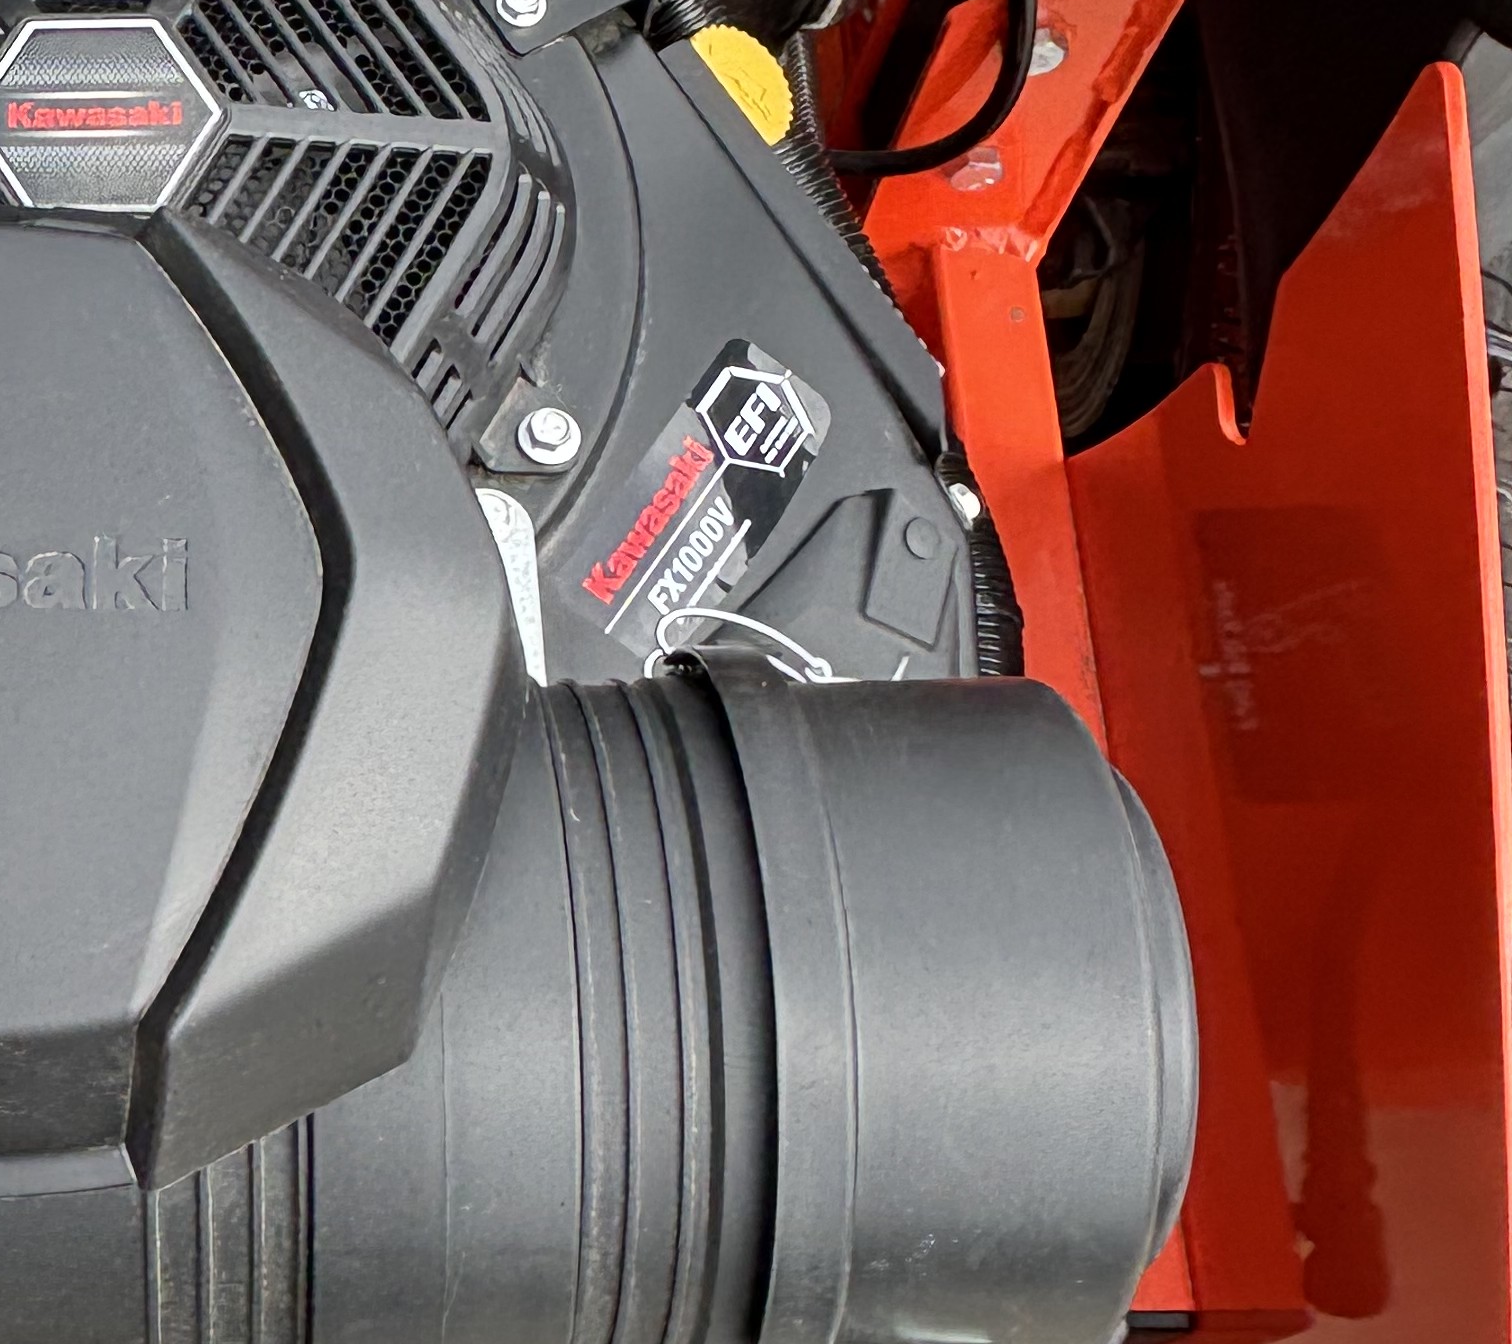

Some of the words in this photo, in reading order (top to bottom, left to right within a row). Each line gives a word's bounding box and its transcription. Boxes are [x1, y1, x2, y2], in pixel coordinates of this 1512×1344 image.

[6, 100, 183, 129] Kawasaki
[724, 382, 781, 456] EFI
[583, 436, 714, 604] Kawasaki
[647, 496, 735, 615] FX1000V
